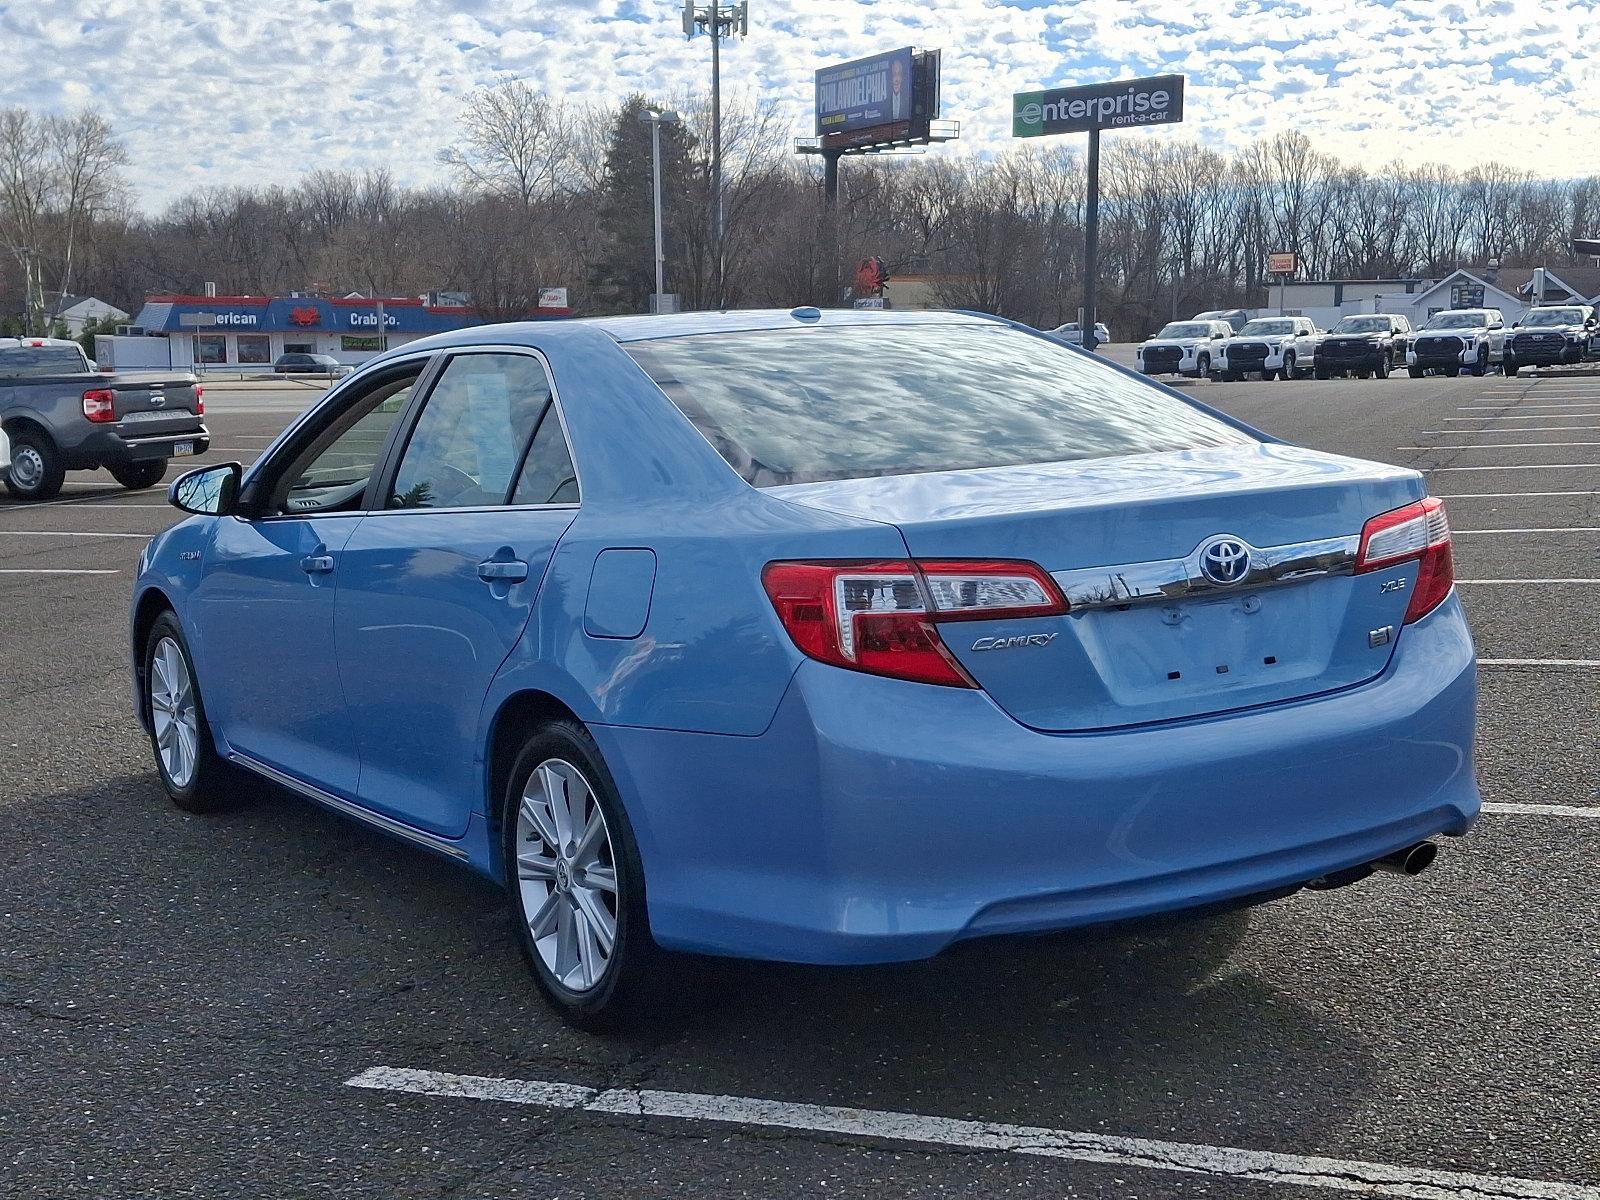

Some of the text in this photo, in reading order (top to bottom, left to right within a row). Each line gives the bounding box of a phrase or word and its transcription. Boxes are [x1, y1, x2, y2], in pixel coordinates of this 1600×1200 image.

[819, 71, 888, 114] PHILAWDELPHIA
[1015, 87, 1170, 124] enterprise
[1111, 110, 1169, 125] rent-a-car
[199, 311, 400, 326] erican Crab Co.
[1380, 577, 1406, 594] XLE
[971, 632, 1059, 651] CAMRY
